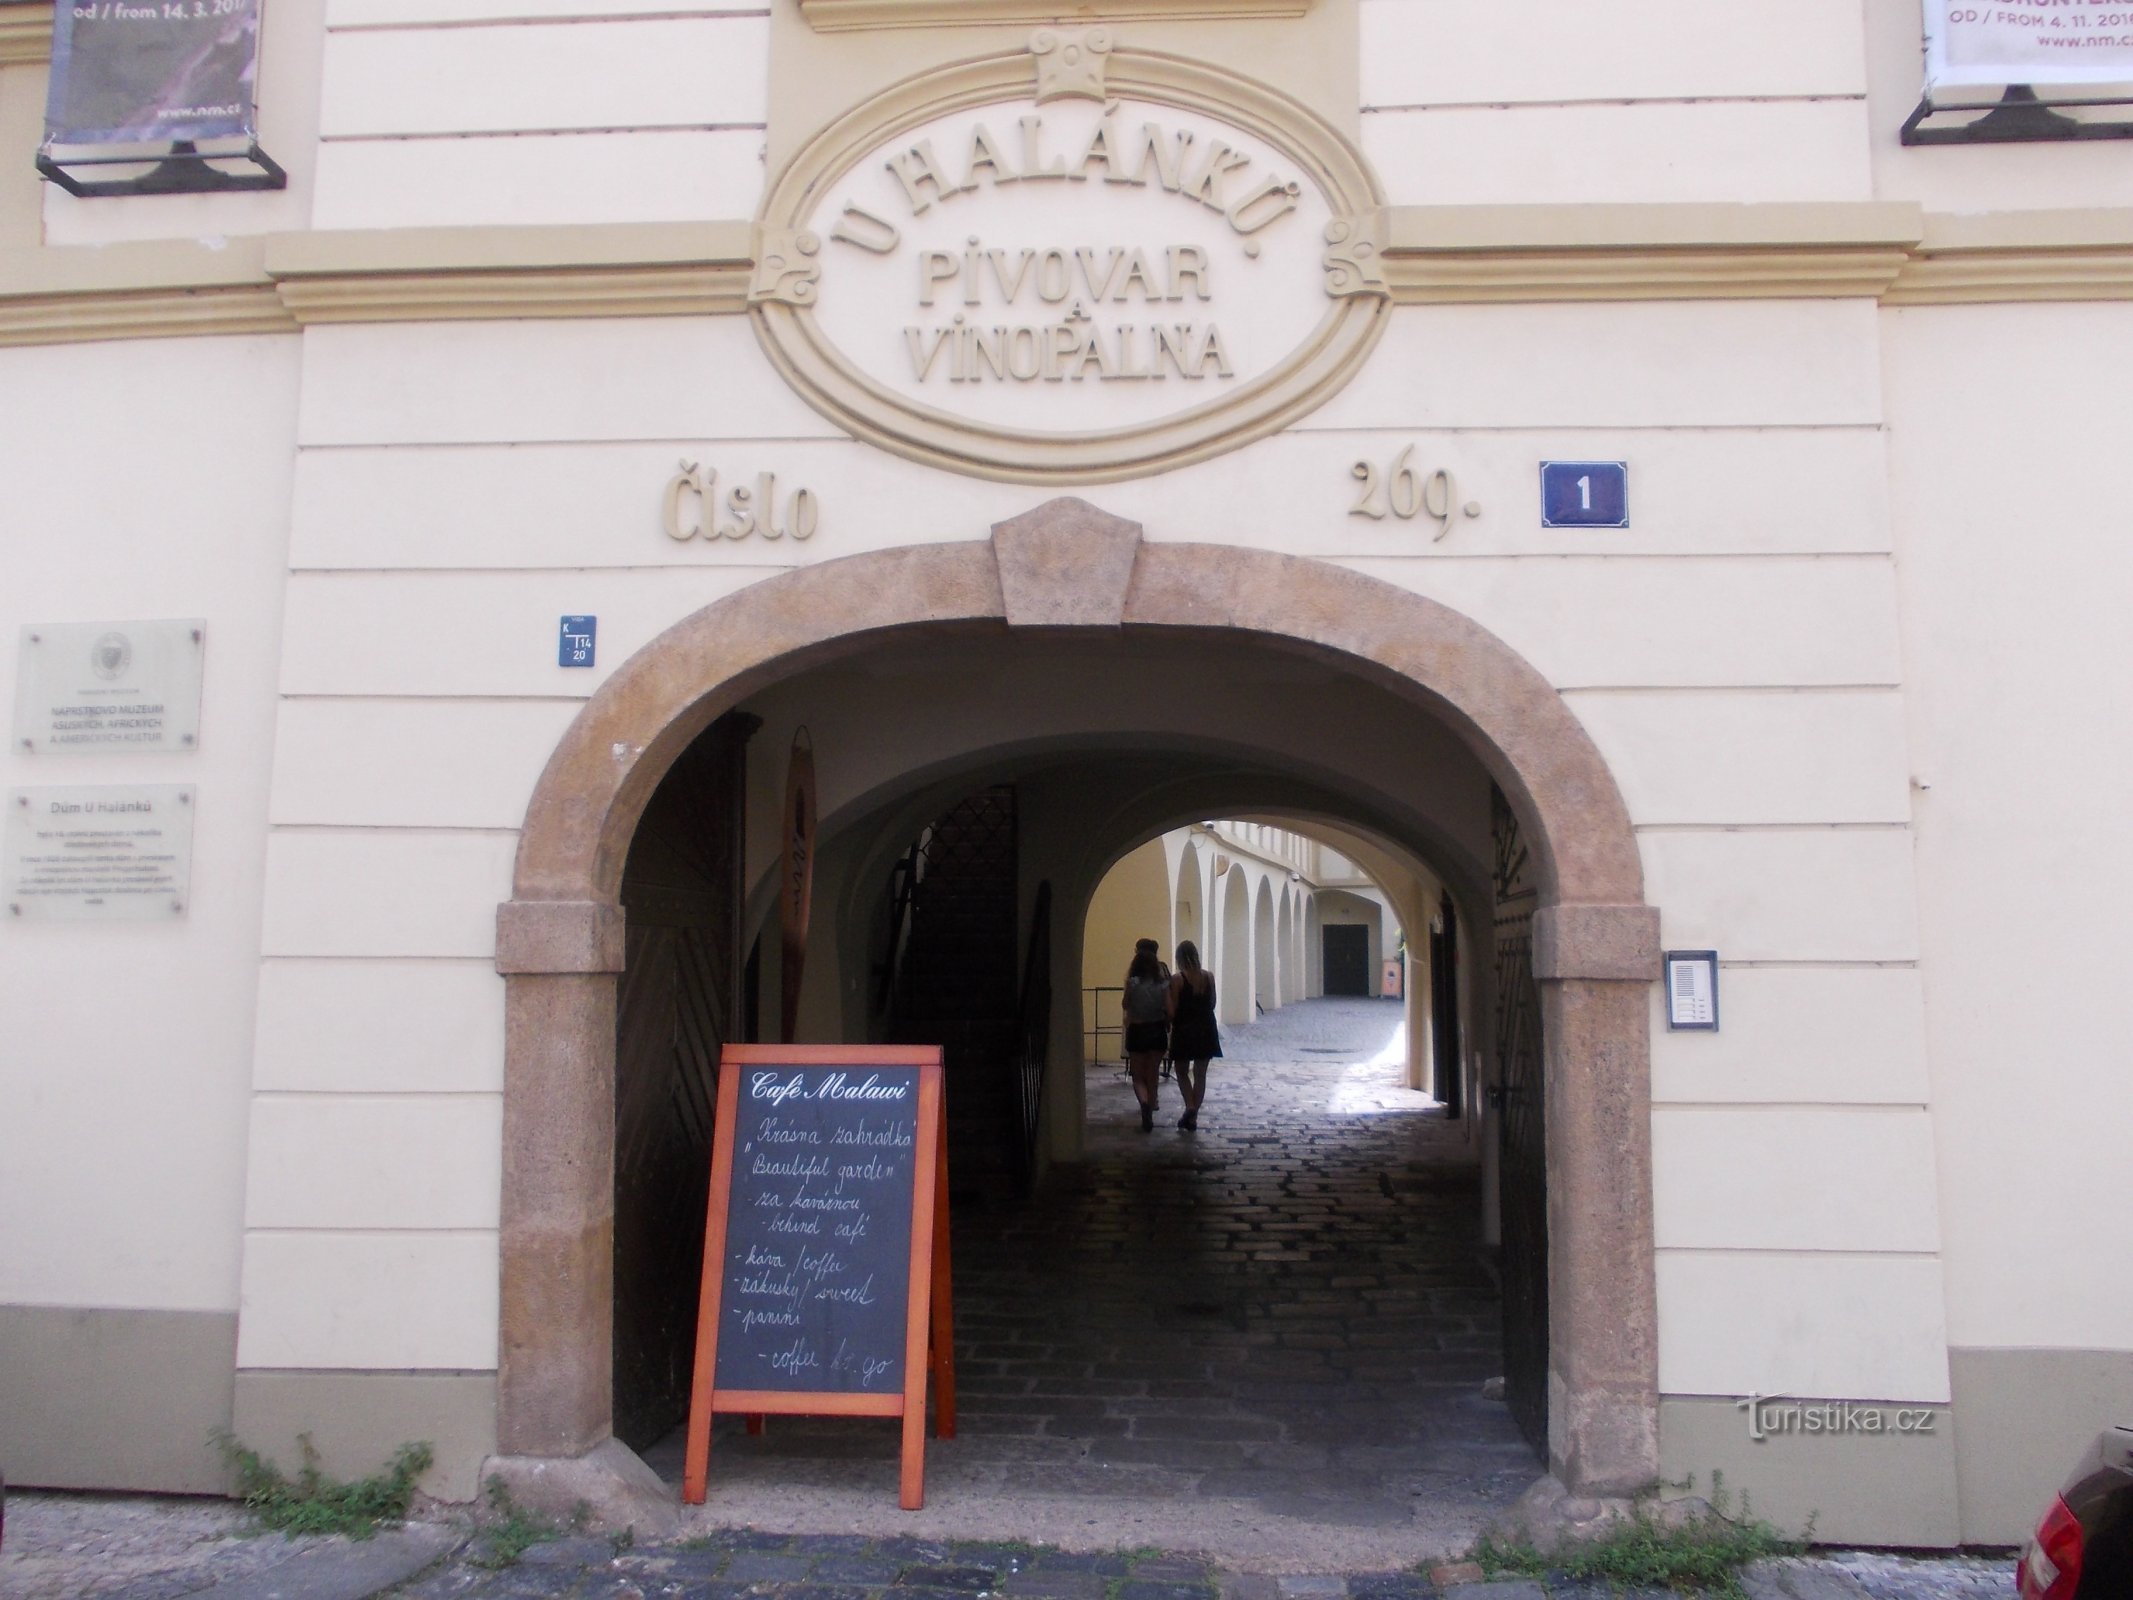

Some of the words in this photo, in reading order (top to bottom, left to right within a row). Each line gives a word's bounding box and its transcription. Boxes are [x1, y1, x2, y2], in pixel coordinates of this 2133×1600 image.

[73, 4, 97, 20] od
[114, 2, 157, 20] from
[162, 3, 189, 20] 14.
[1950, 10, 1978, 24] OD
[1996, 11, 2045, 28] FROM
[2050, 16, 2067, 28] 4.
[2072, 15, 2092, 28] 11.
[2036, 34, 2133, 48] www.nm.c
[831, 199, 902, 256] U
[1576, 474, 1591, 510] 1
[562, 623, 570, 633] K
[572, 649, 586, 661] 20
[118, 703, 165, 715] MUZEUM
[84, 801, 95, 813] U
[752, 1072, 803, 1107] Café
[804, 1072, 910, 1099] Malawi
[862, 1357, 895, 1387] go
